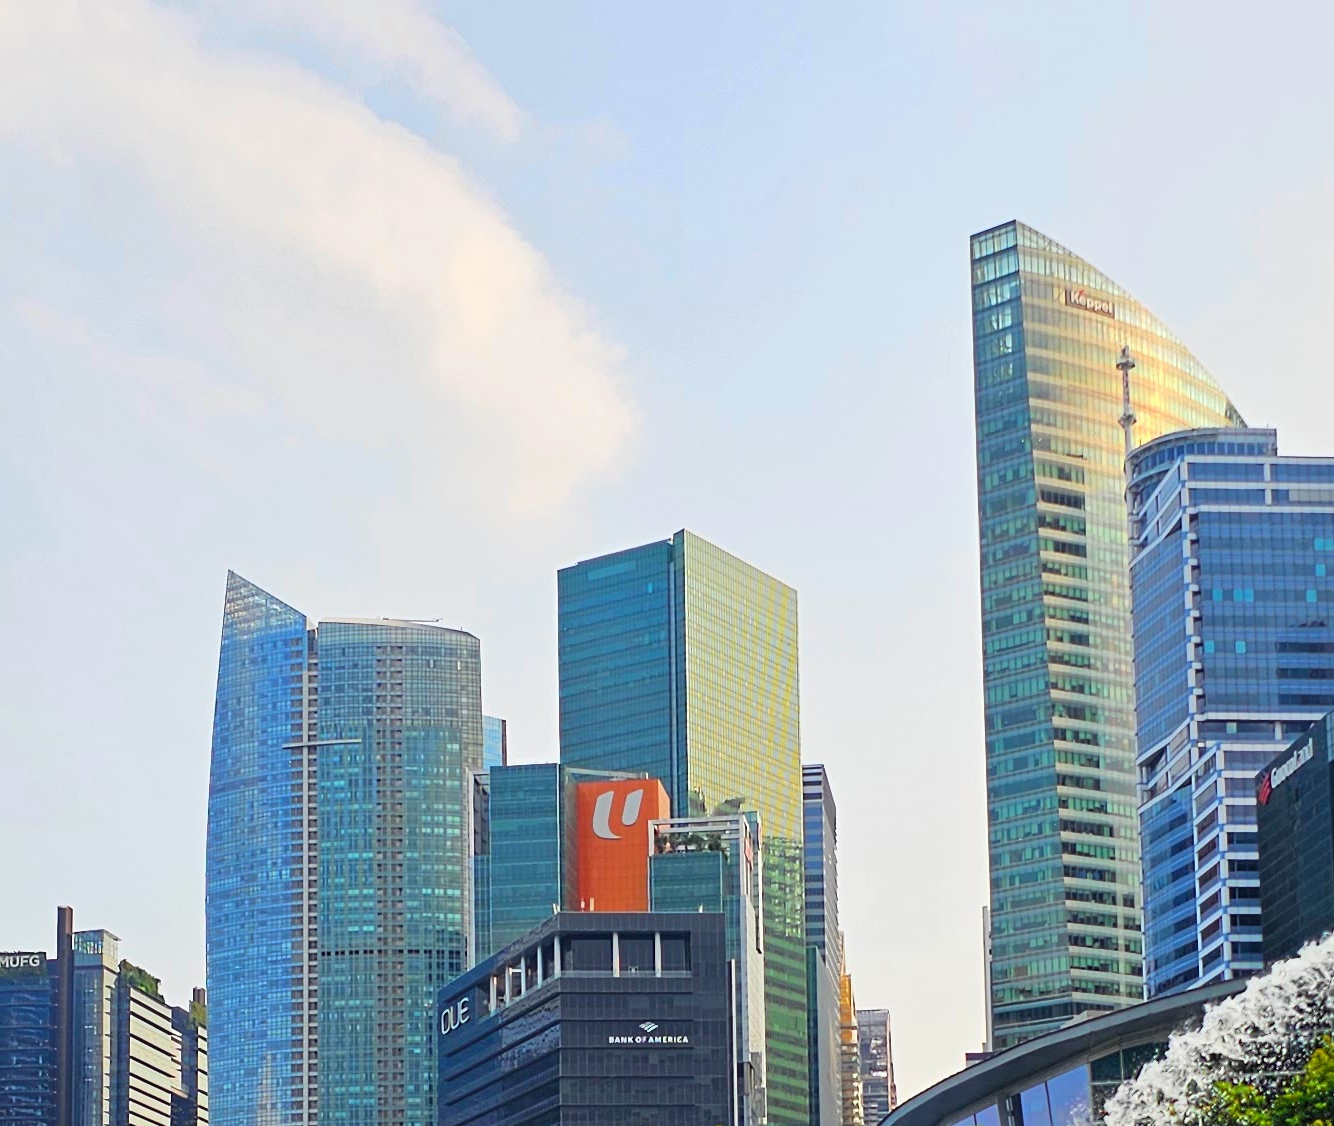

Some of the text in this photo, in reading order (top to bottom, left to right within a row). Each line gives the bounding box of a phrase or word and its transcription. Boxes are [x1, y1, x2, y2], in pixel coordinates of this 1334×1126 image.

[1070, 288, 1113, 315] Keppel
[440, 997, 470, 1036] OUE
[608, 1035, 689, 1044] BANK OF AMERICA
